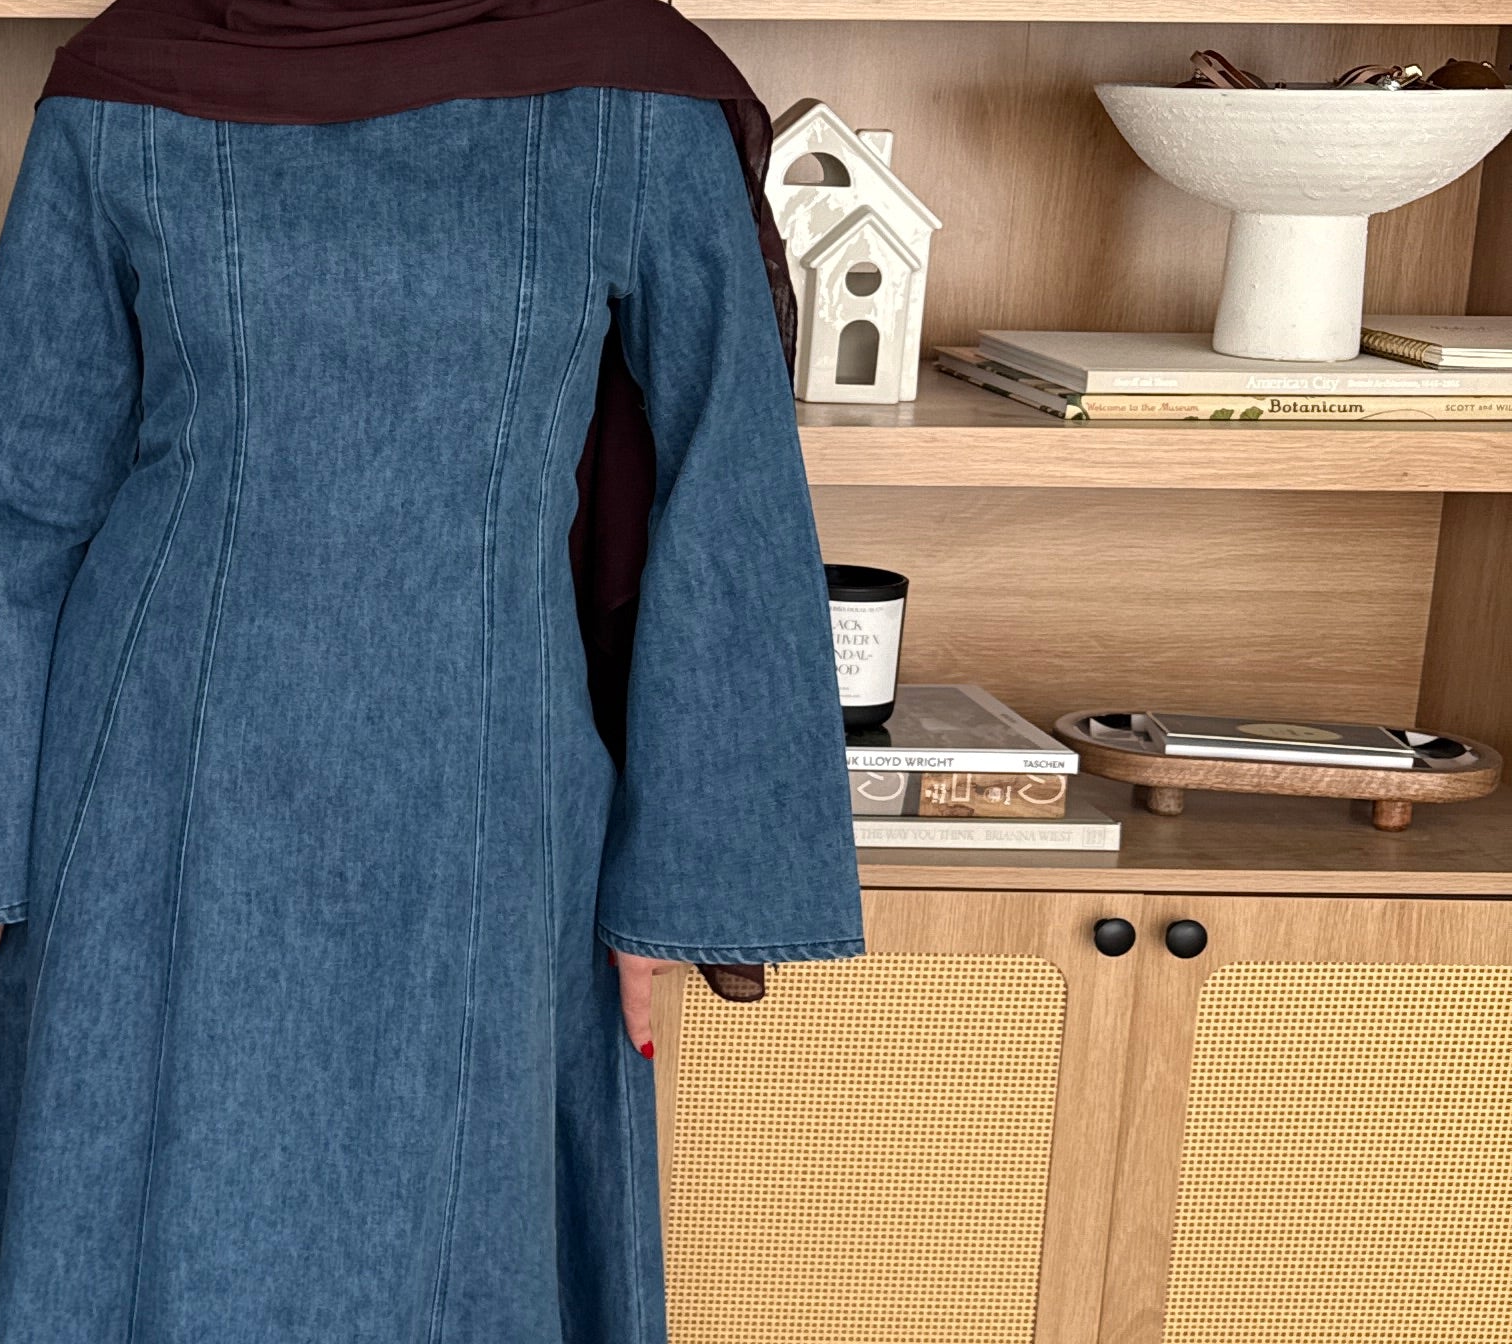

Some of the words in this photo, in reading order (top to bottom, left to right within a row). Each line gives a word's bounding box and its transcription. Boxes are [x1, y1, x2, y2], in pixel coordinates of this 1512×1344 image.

[1246, 377, 1308, 390] American
[1312, 376, 1341, 391] City
[1086, 402, 1126, 412] Welcome
[1129, 404, 1139, 412] to
[1141, 403, 1156, 412] the
[1159, 403, 1199, 412] Museum
[1268, 399, 1365, 413] Botanicum
[1445, 404, 1475, 412] SCOTT
[863, 757, 902, 767] LLOYD
[906, 757, 955, 768] WRIGHT
[1023, 760, 1065, 769] TASCHEN
[861, 828, 887, 840] THE
[887, 829, 910, 841] WAY
[911, 829, 937, 841] YOU
[938, 830, 975, 841] THINK
[984, 830, 1037, 841] BRIANNA
[1038, 831, 1074, 842] WIEST
